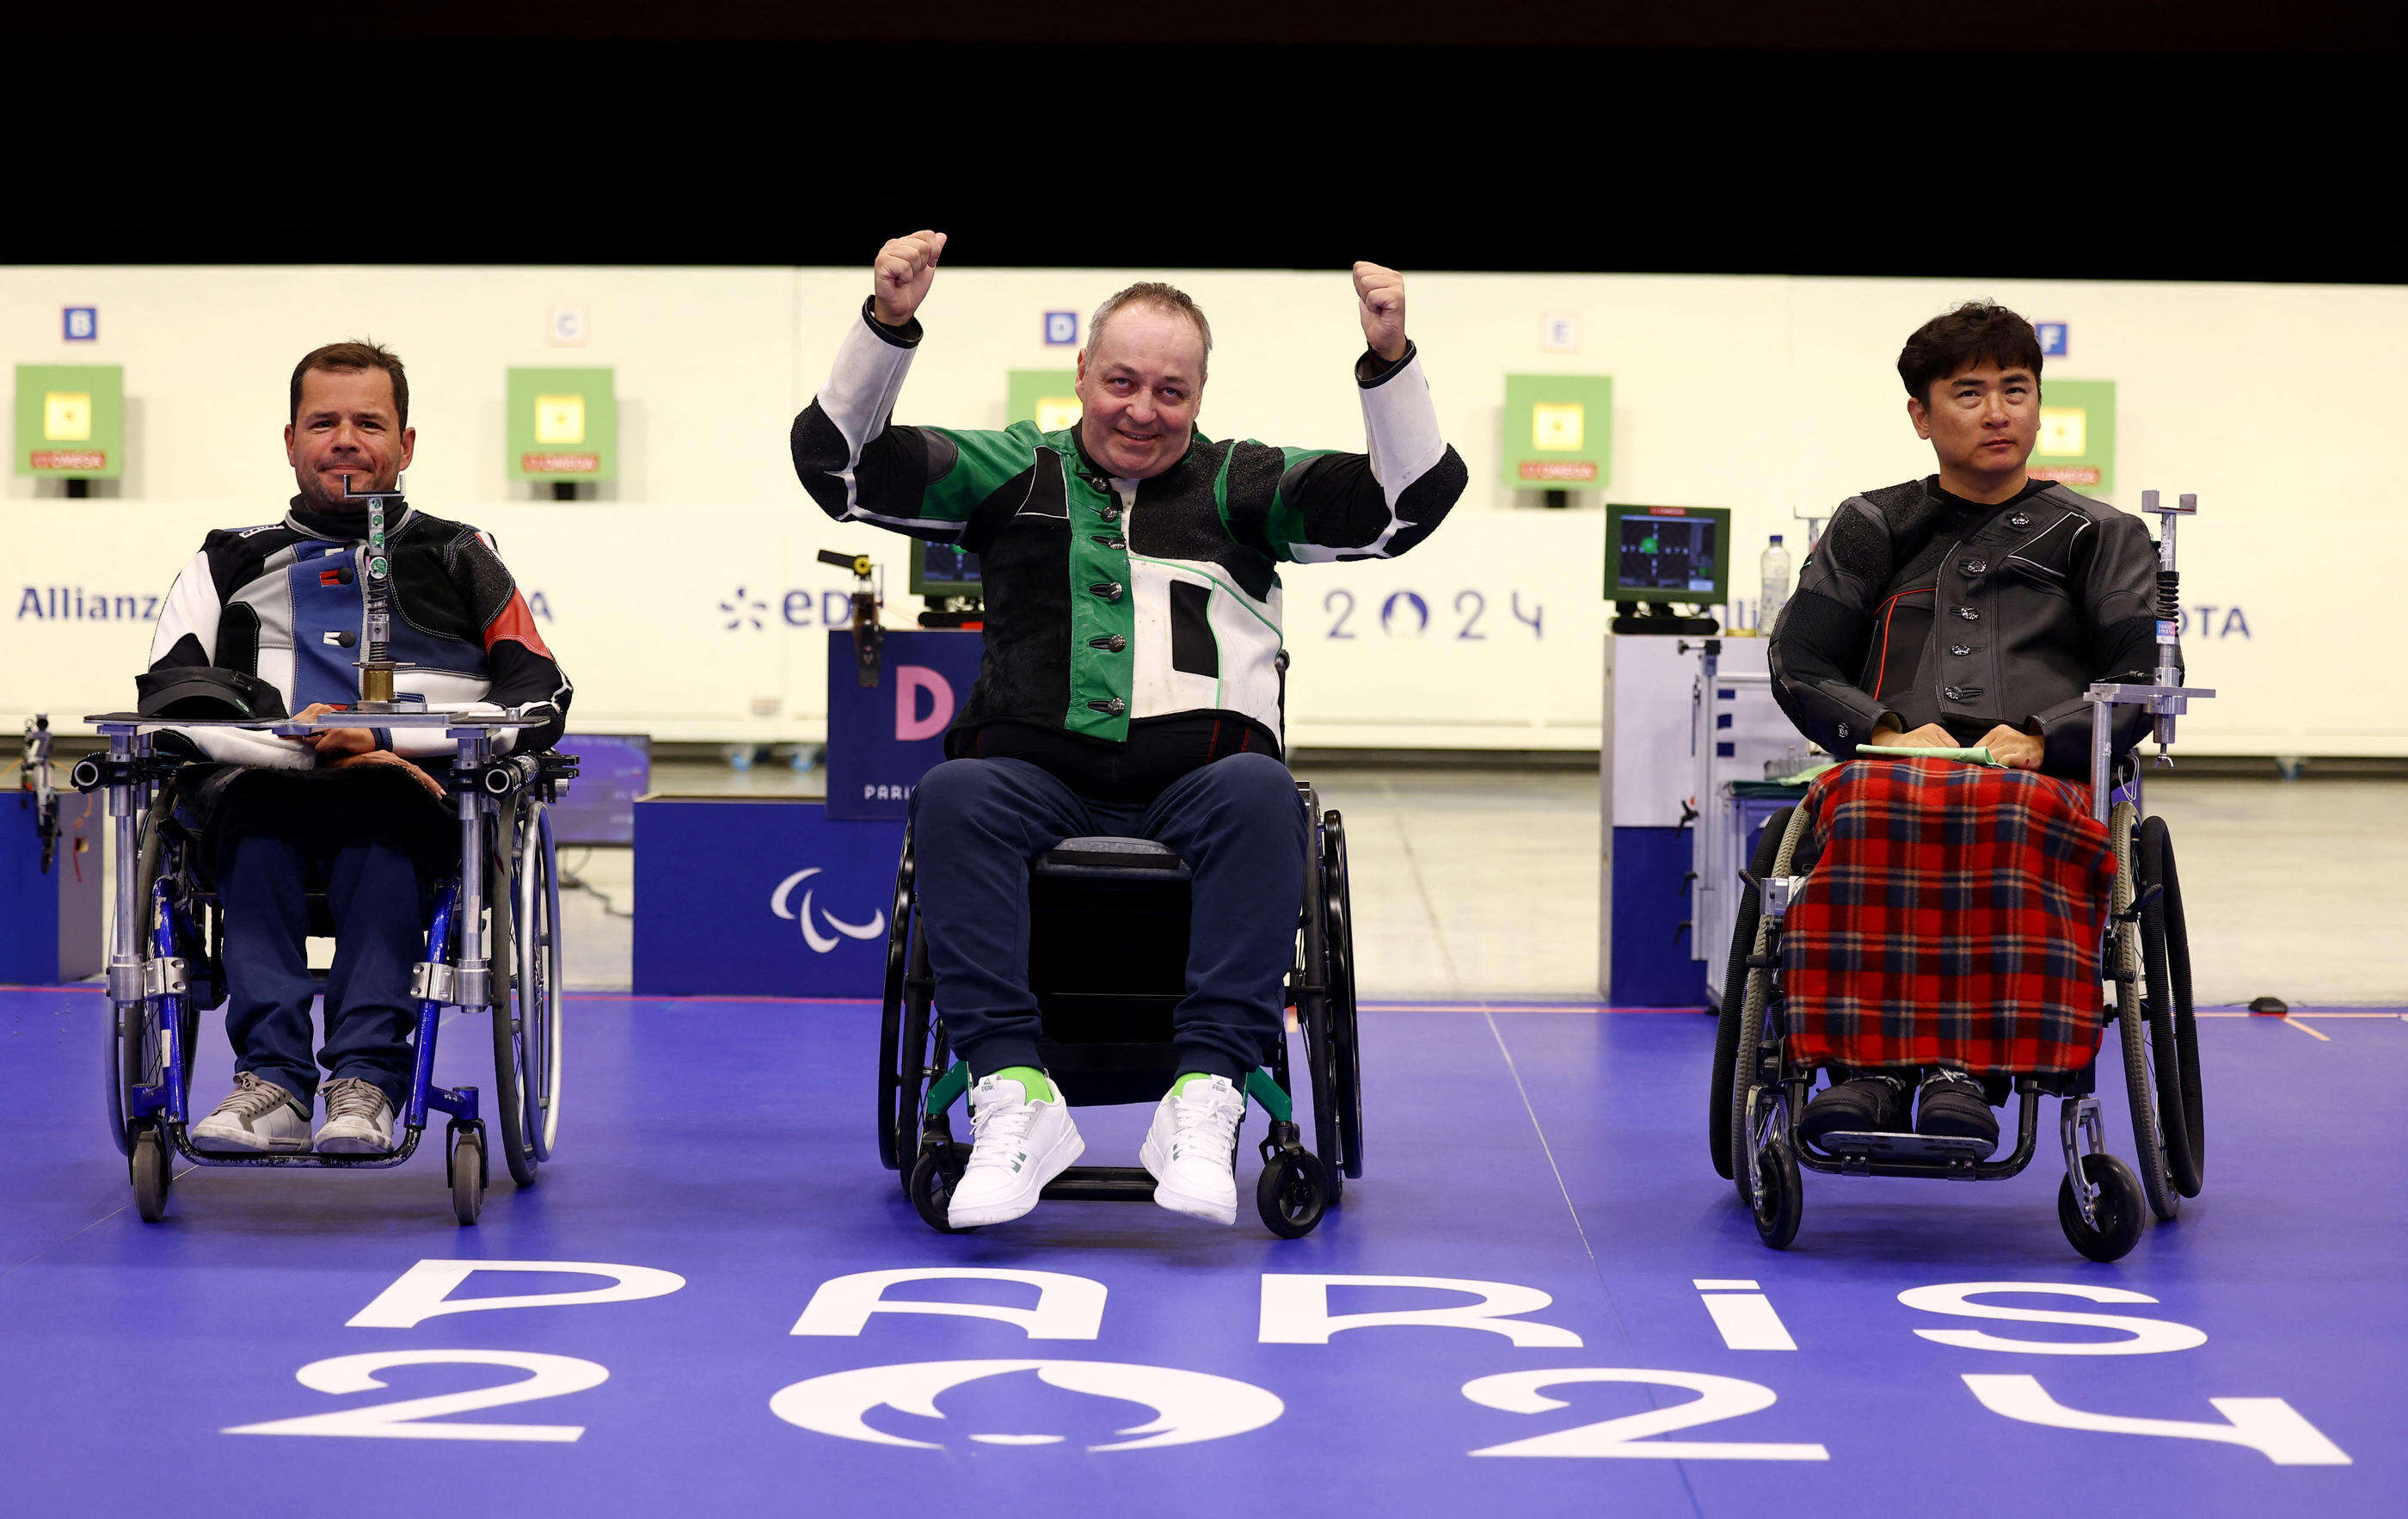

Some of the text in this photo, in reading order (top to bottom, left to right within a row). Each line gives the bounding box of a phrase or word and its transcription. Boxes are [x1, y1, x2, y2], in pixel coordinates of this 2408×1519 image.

[69, 309, 92, 337] B
[557, 313, 576, 336] C
[1049, 314, 1075, 341] D
[2040, 324, 2062, 353] F
[16, 587, 160, 620] Allianz
[1324, 588, 1545, 639] 2024
[895, 665, 955, 741] D
[863, 784, 915, 801] PARI
